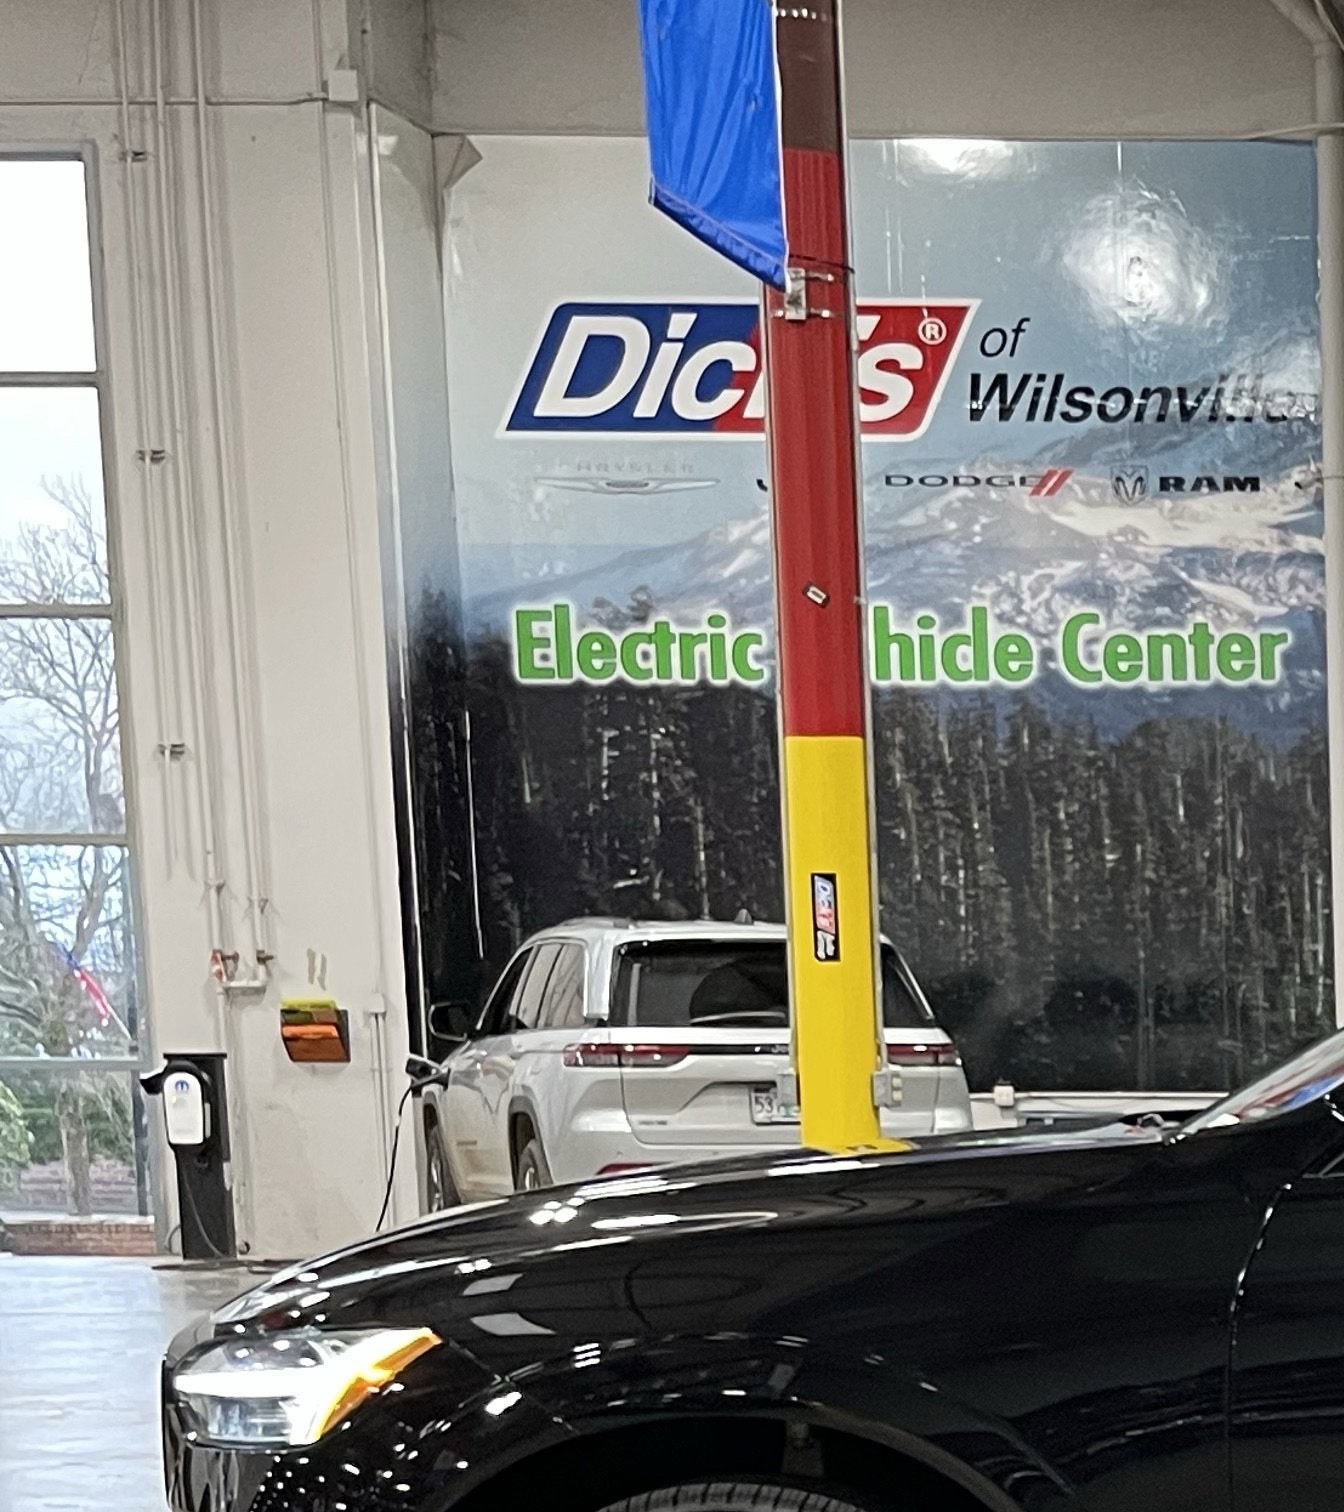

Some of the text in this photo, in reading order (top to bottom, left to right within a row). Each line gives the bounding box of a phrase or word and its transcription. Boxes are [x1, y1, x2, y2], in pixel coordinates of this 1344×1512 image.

[979, 317, 1031, 358] of
[533, 312, 924, 422] Dic's
[885, 474, 1044, 488] DODGE
[1159, 476, 1260, 492] RAM
[515, 604, 765, 681] Electric
[873, 606, 1289, 682] hicle Center
